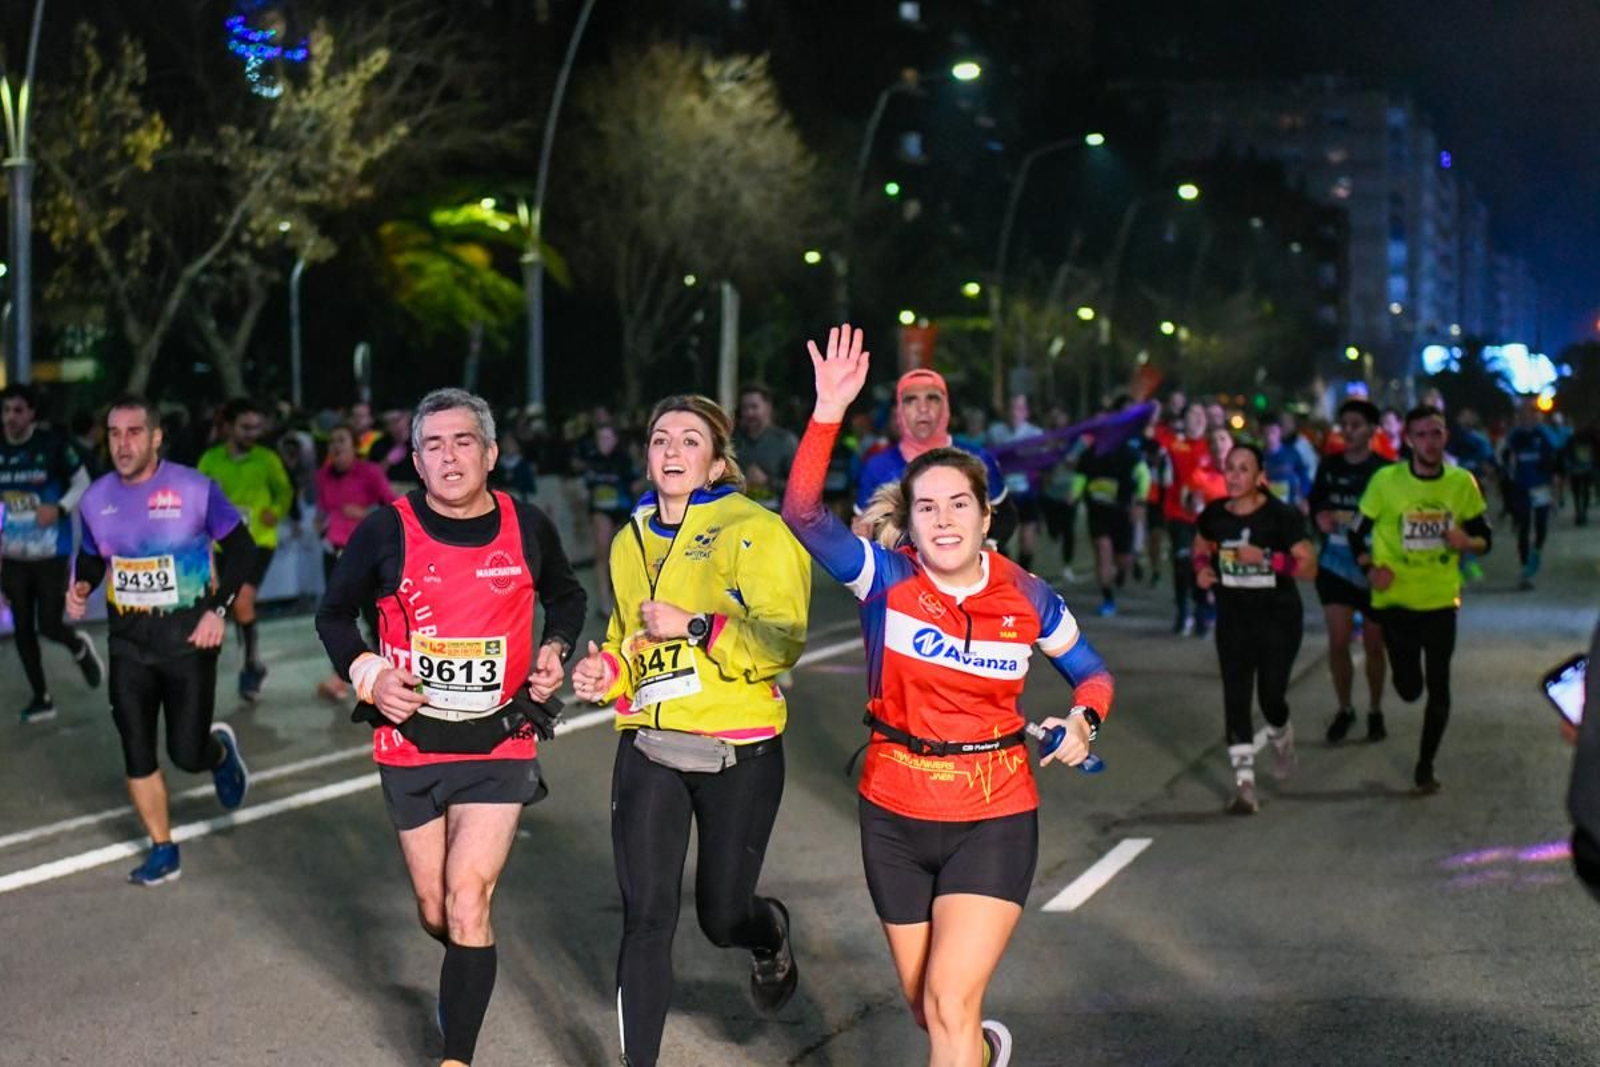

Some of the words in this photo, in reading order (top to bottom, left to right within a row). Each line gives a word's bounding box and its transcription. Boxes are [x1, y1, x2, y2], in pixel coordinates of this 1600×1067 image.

[118, 570, 169, 589] 9439
[400, 578, 437, 637] CLUB
[418, 655, 497, 683] 9613
[944, 644, 1018, 671] Avanza
